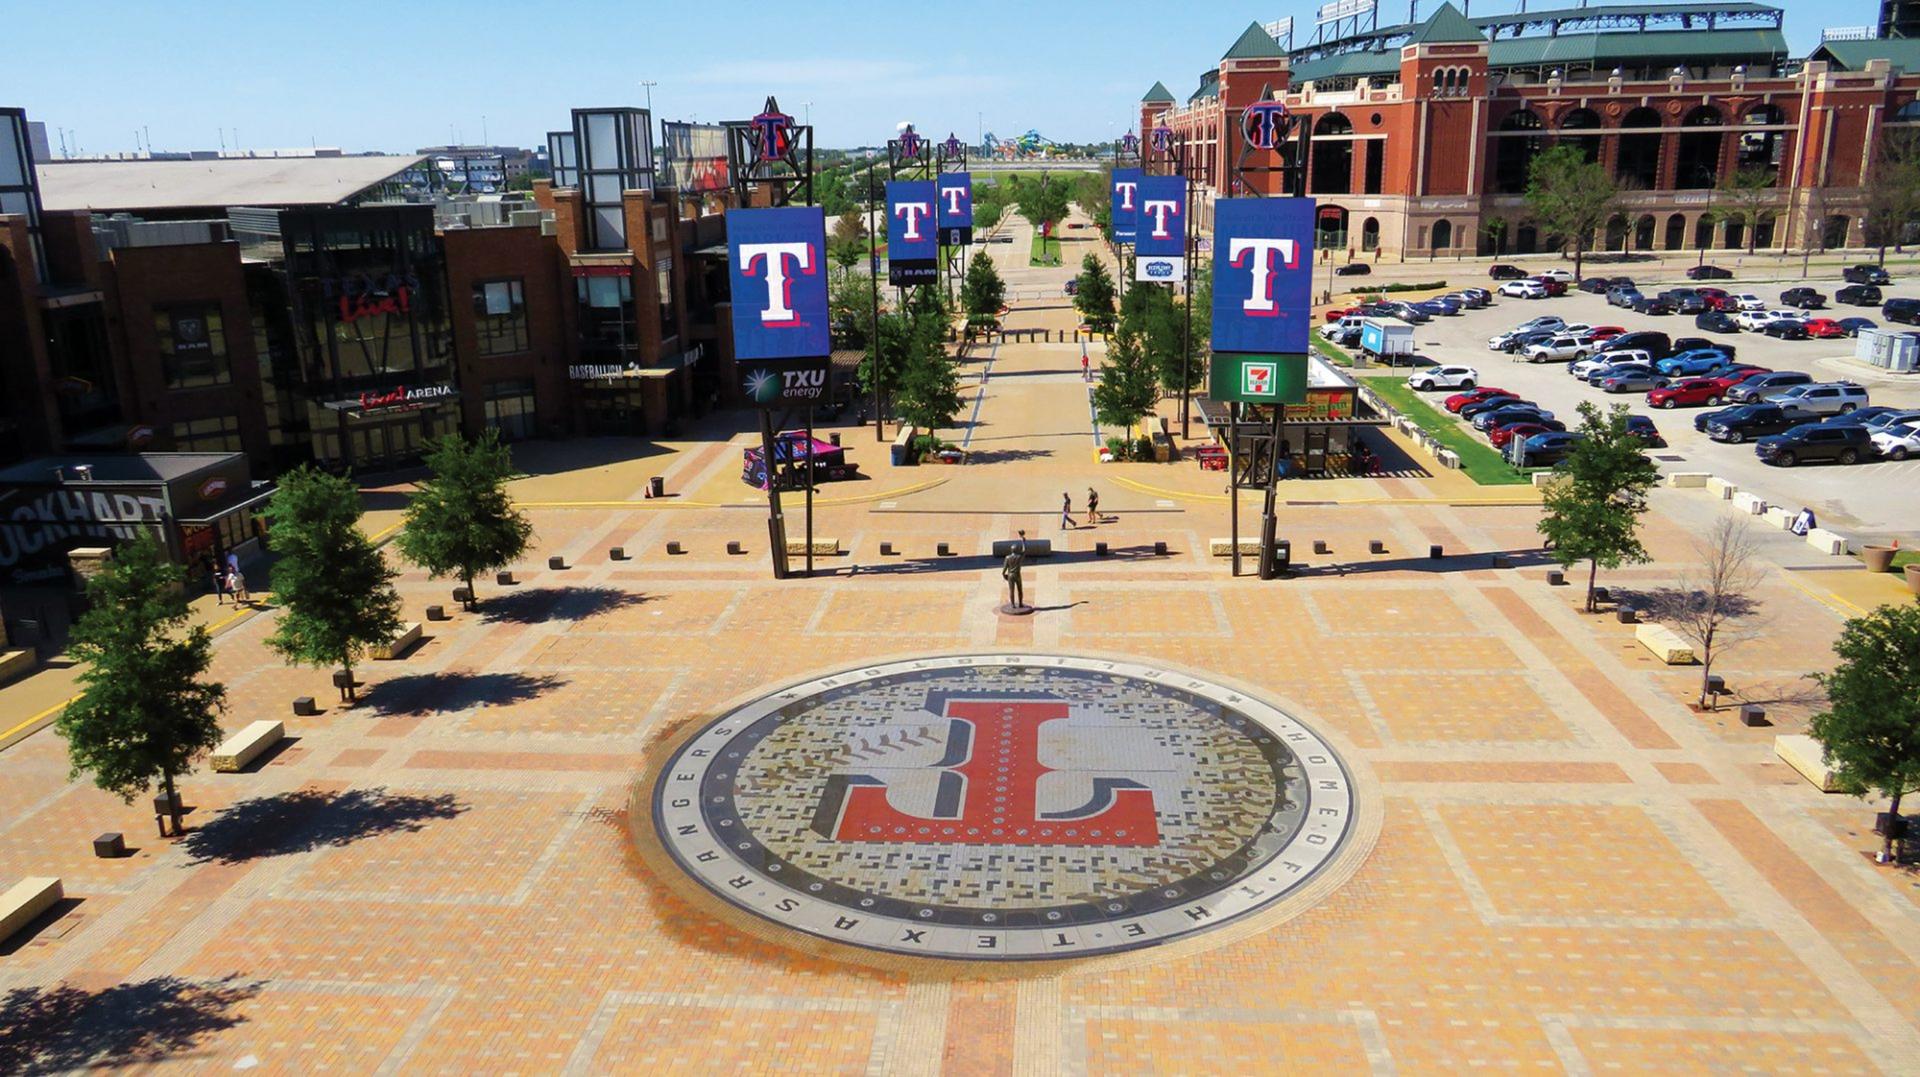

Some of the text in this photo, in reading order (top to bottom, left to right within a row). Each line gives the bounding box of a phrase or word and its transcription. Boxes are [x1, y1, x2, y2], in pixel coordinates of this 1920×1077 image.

[752, 113, 791, 160] T
[942, 187, 968, 214] T
[895, 202, 931, 241] T
[1145, 201, 1178, 239] T
[739, 243, 816, 327] T
[1230, 238, 1299, 316] T
[406, 386, 451, 399] ARENA
[783, 369, 825, 387] TXU
[783, 386, 823, 399] energy
[672, 727, 1339, 948] HOME OF THE TEXAS RANGERS
